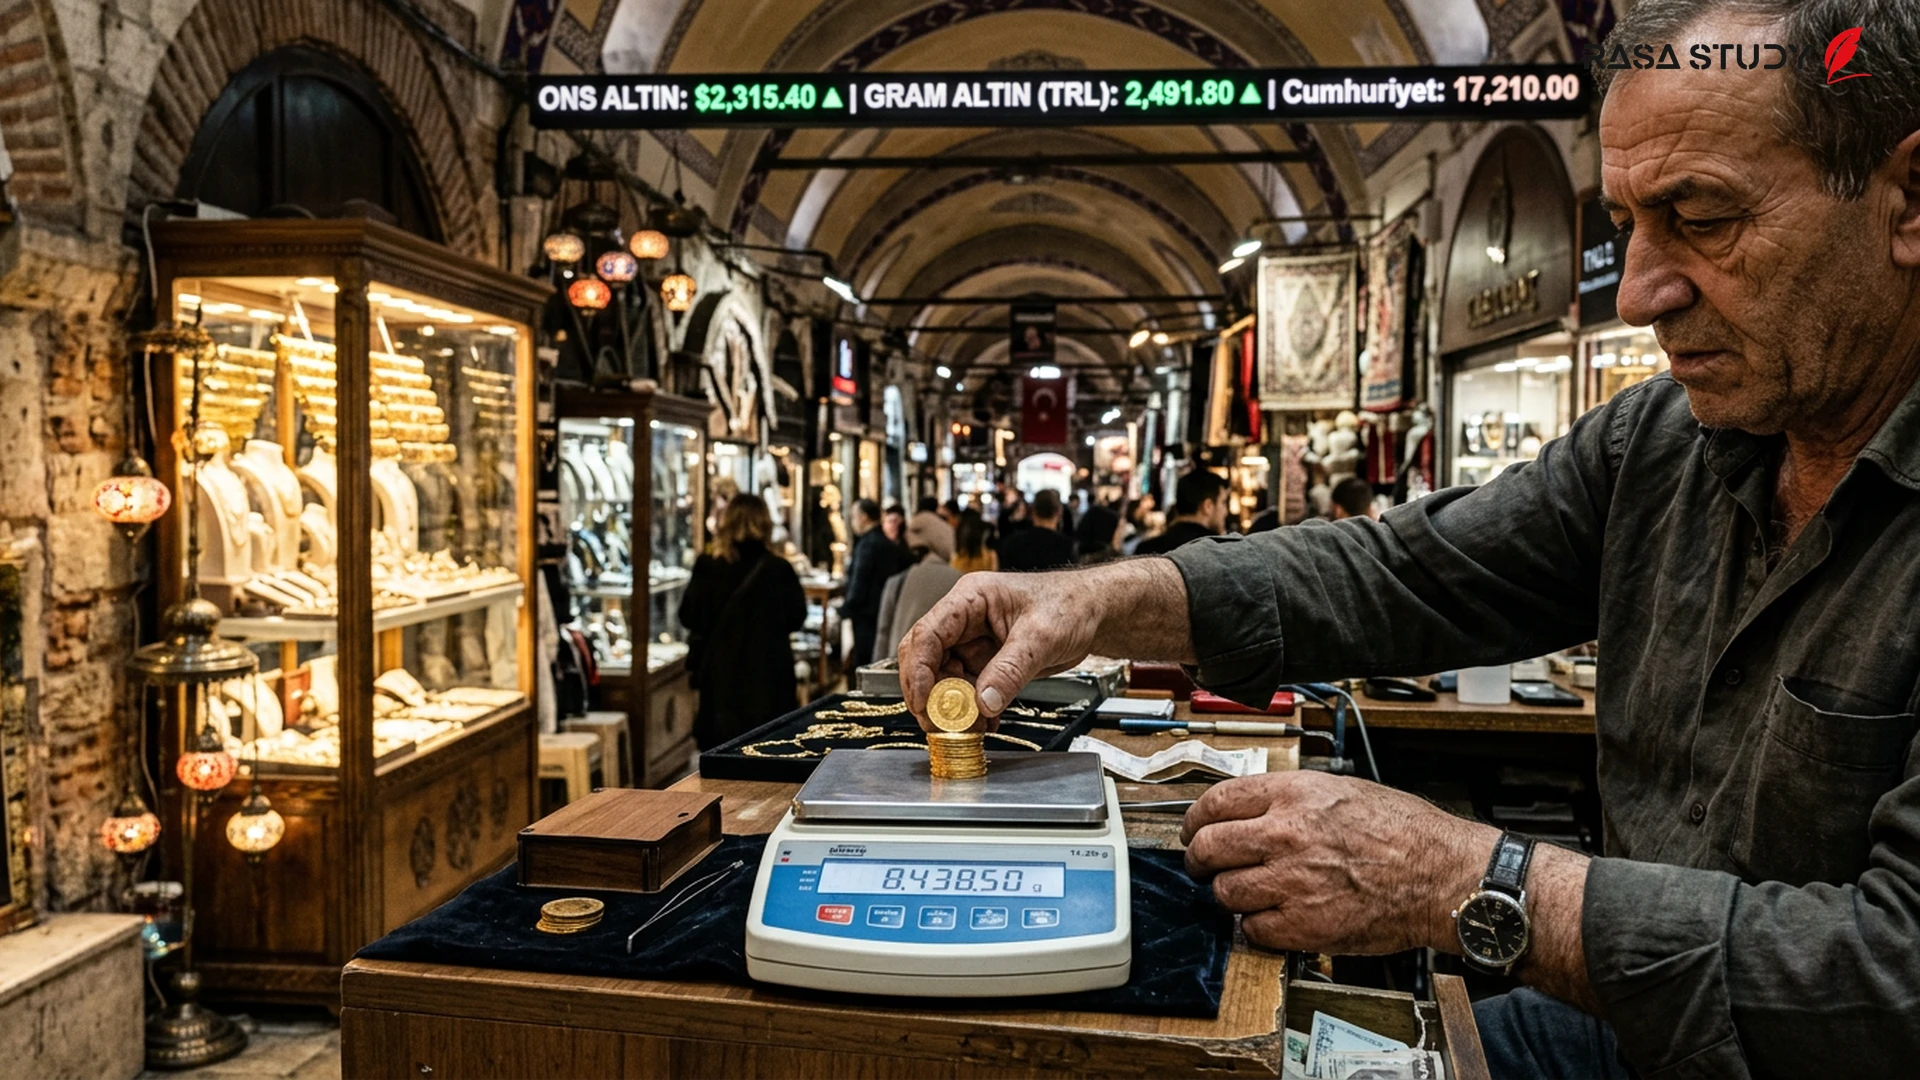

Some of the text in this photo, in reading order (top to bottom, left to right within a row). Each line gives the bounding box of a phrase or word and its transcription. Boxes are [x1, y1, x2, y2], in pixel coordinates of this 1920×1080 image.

[538, 85, 598, 112] ONS
[601, 84, 688, 111] ALTIN:
[694, 83, 817, 114] $2,315.40
[863, 82, 948, 109] GRAM
[951, 81, 1032, 108] ALTIN
[1037, 80, 1119, 113] (TRL):
[1124, 79, 1235, 111] 2,491.80
[1281, 77, 1446, 109] Cumhuriyet:
[1453, 75, 1579, 106] 17,210.00
[882, 867, 1023, 892] 8.438.50
